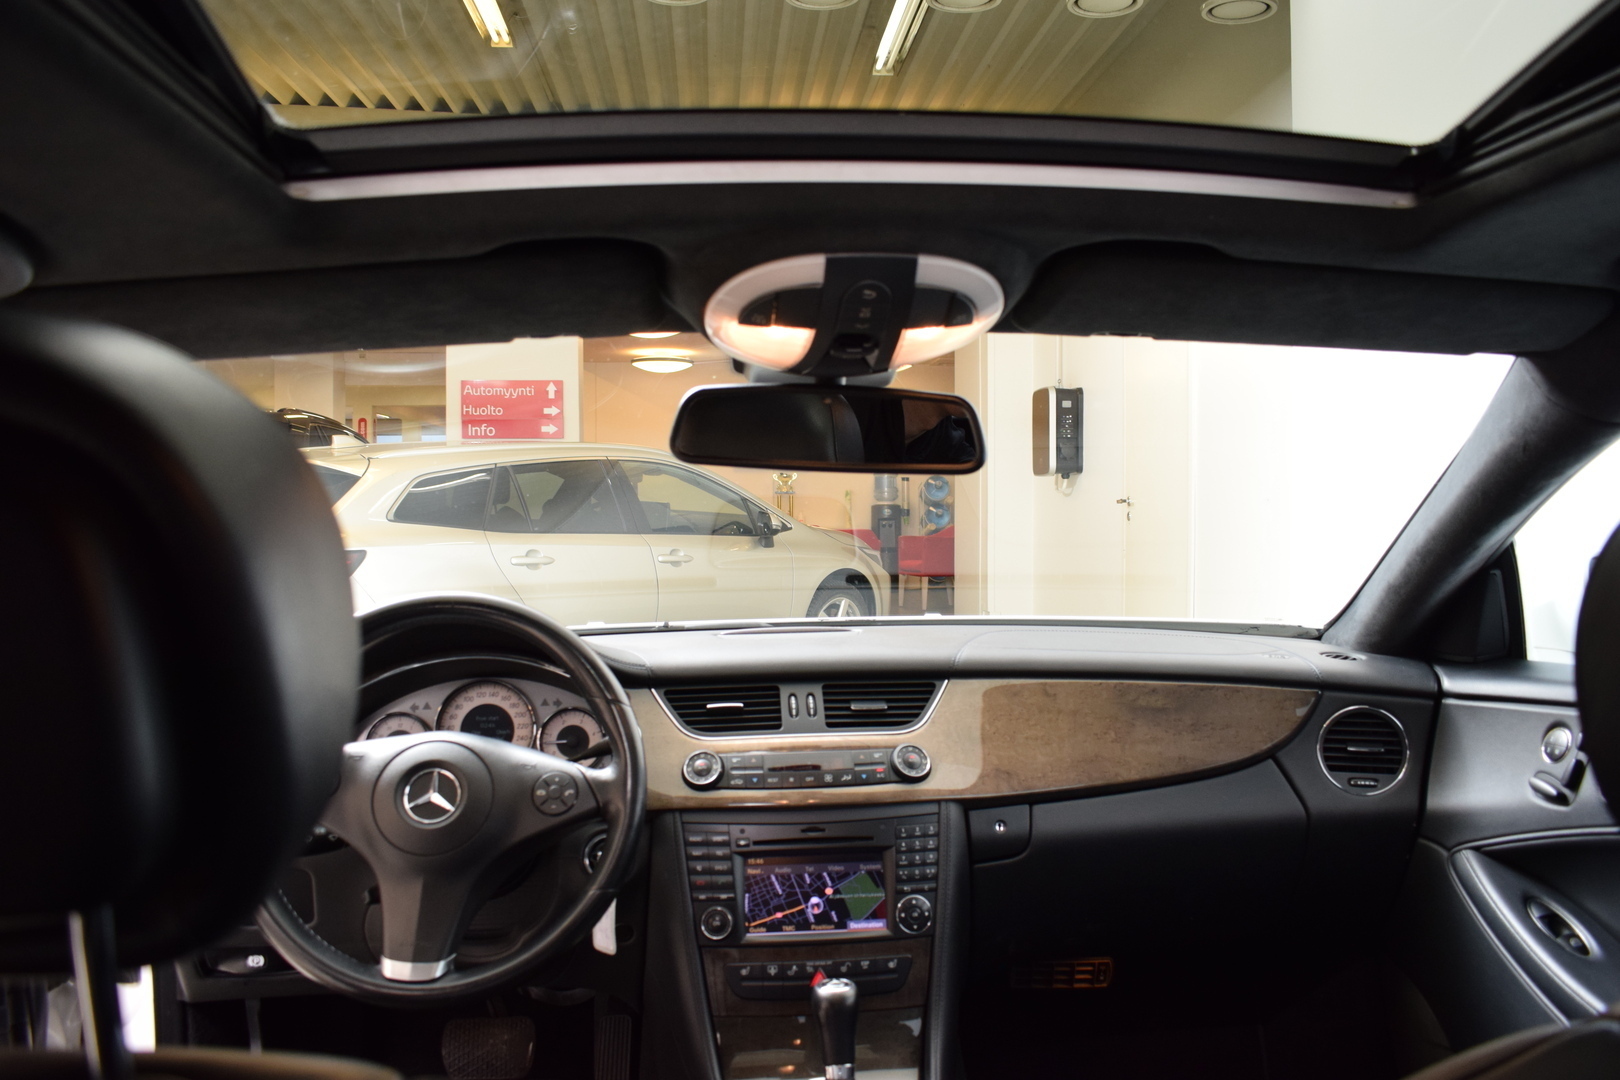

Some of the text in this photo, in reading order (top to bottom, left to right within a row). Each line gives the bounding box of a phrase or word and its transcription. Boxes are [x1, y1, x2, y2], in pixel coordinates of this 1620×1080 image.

[463, 385, 535, 399] Automyynti
[463, 405, 504, 416] Huolto
[468, 423, 496, 436] Info
[850, 921, 883, 929] Destination
